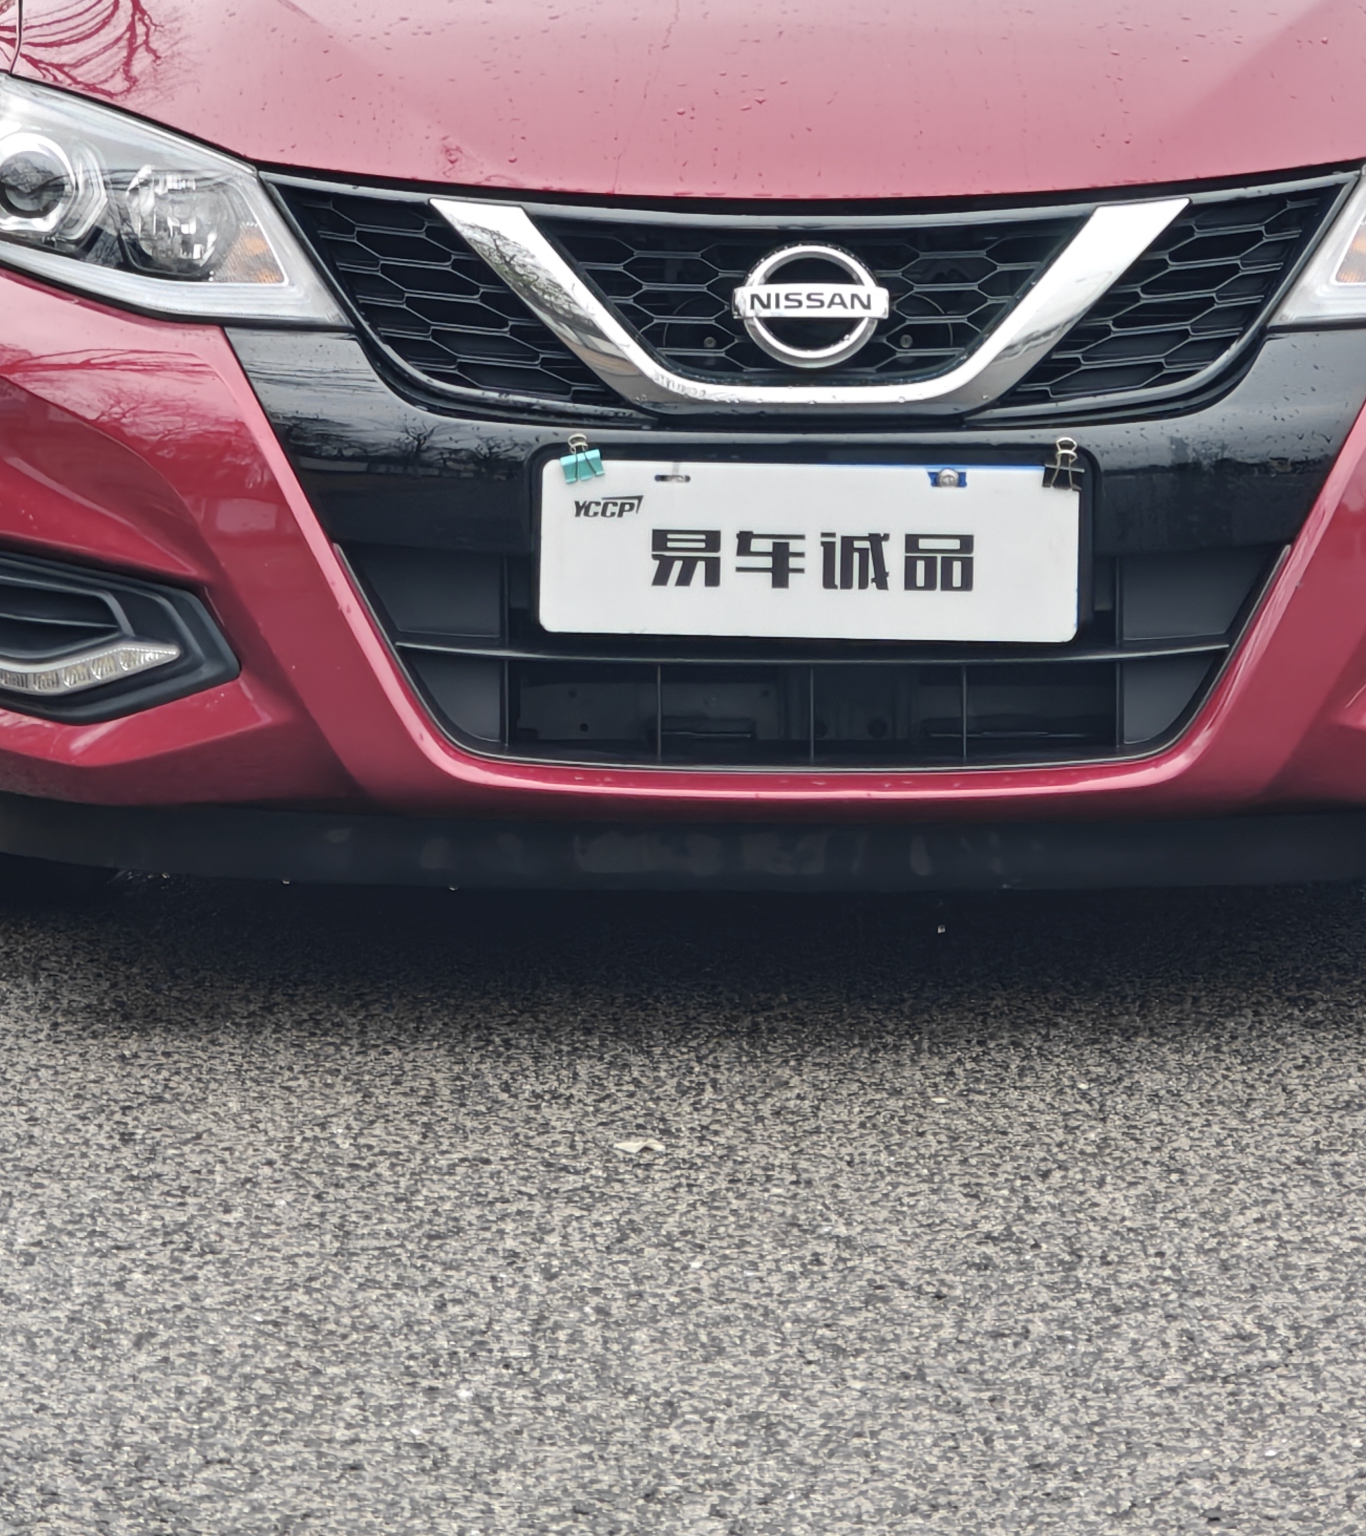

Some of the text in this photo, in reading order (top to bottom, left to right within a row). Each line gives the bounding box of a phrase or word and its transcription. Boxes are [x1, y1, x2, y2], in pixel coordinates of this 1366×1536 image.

[749, 292, 872, 311] NISSAN
[574, 494, 644, 518] YCCP
[651, 529, 975, 592] 易车诚品
